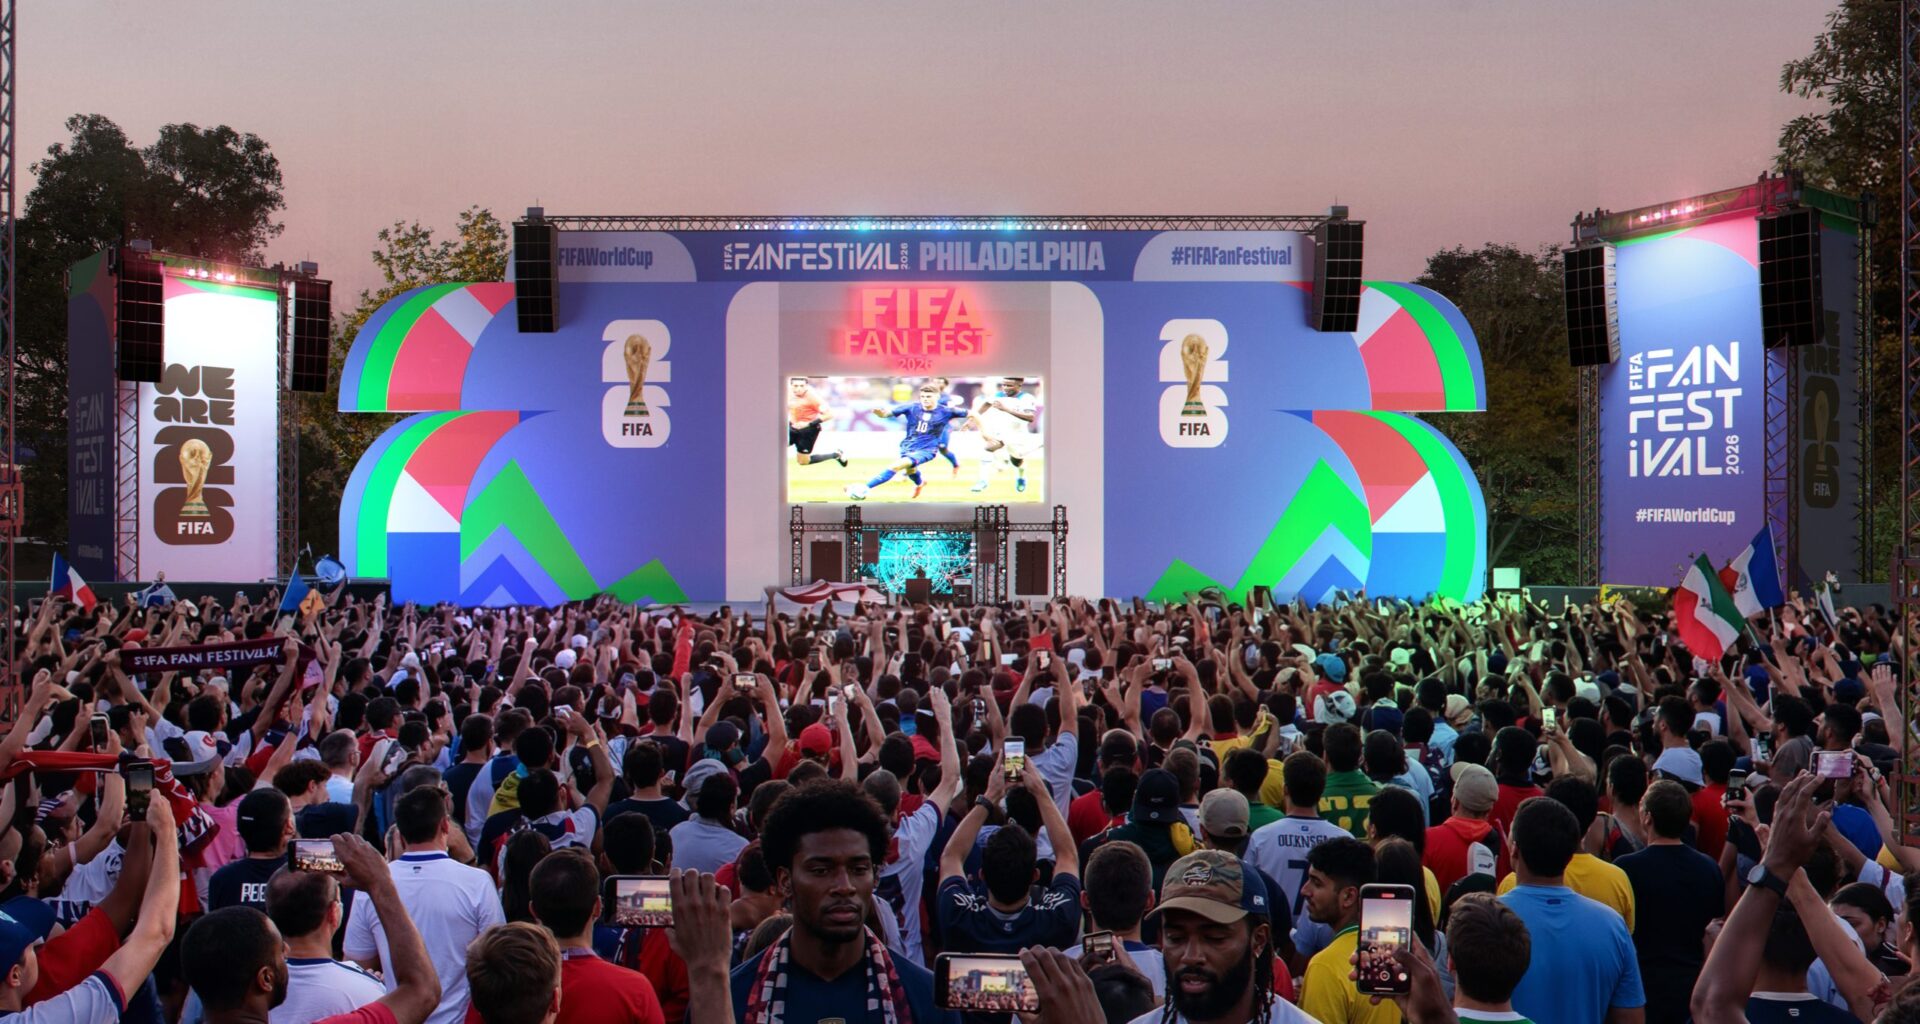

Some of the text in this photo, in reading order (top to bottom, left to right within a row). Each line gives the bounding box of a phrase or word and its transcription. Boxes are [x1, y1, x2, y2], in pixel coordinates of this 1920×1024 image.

[724, 243, 733, 270] FIFA
[901, 243, 909, 270] 2026
[919, 241, 1106, 271] PHILADELPHIA
[1171, 245, 1292, 266] #FIFAFanFestival
[862, 288, 984, 329] FIFA
[845, 330, 993, 356] FAN FEST
[899, 358, 934, 371] 2026
[1629, 341, 1740, 391] FIFA FAN
[153, 362, 235, 401] WE
[1629, 387, 1742, 434] FEST
[622, 423, 653, 436] FIFA
[1179, 423, 1210, 436] FIFA
[1725, 434, 1740, 475] 2026
[1813, 482, 1831, 497] FIFA
[177, 521, 215, 535] FIFA
[1635, 507, 1736, 526] #FIFAWorldCup
